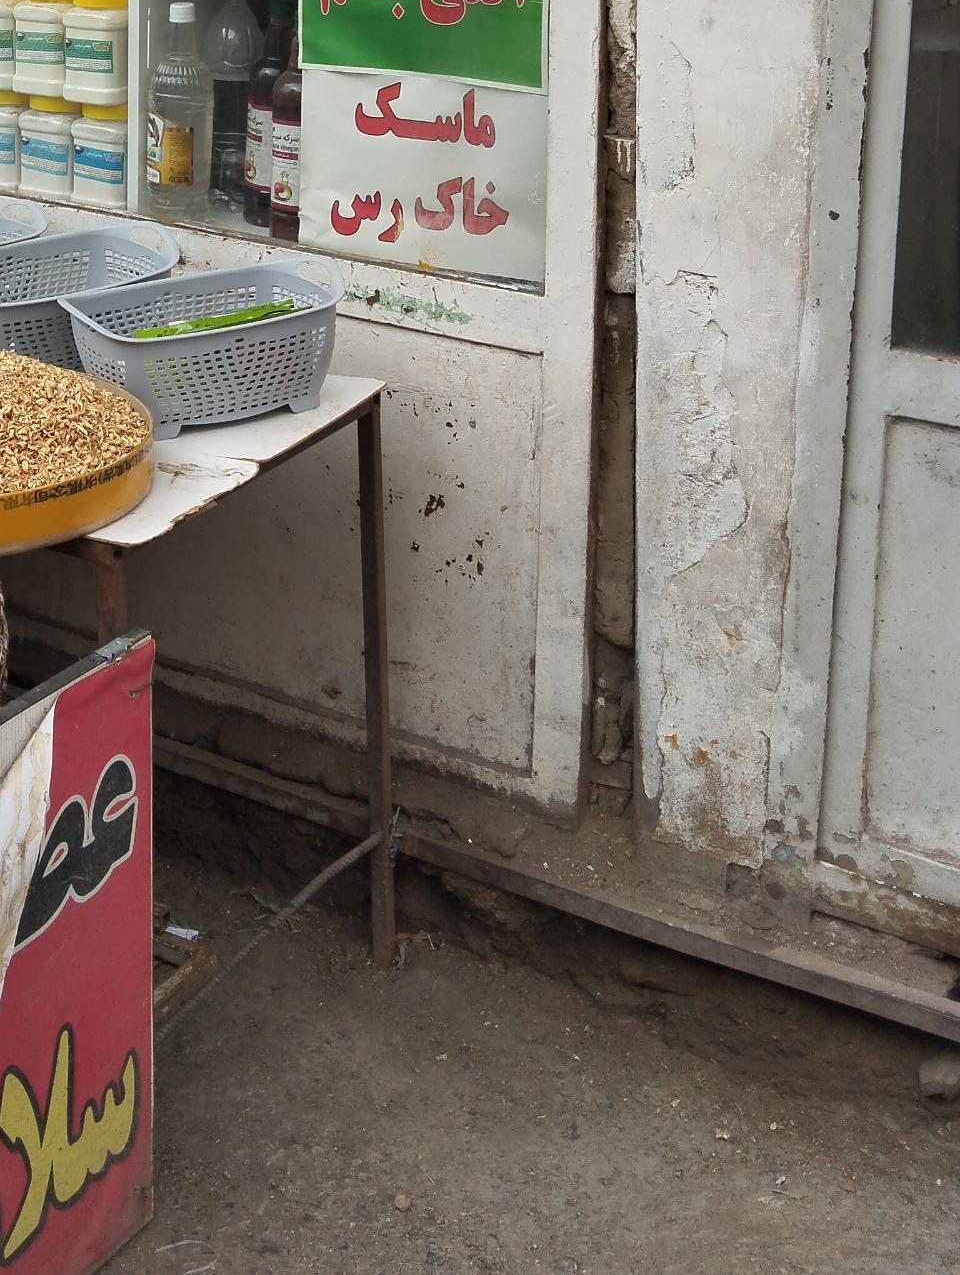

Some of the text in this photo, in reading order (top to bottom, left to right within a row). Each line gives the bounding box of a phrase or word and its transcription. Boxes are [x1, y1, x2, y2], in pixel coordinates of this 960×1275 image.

[355, 82, 496, 148] ماسک
[330, 176, 509, 243] خاک رس
